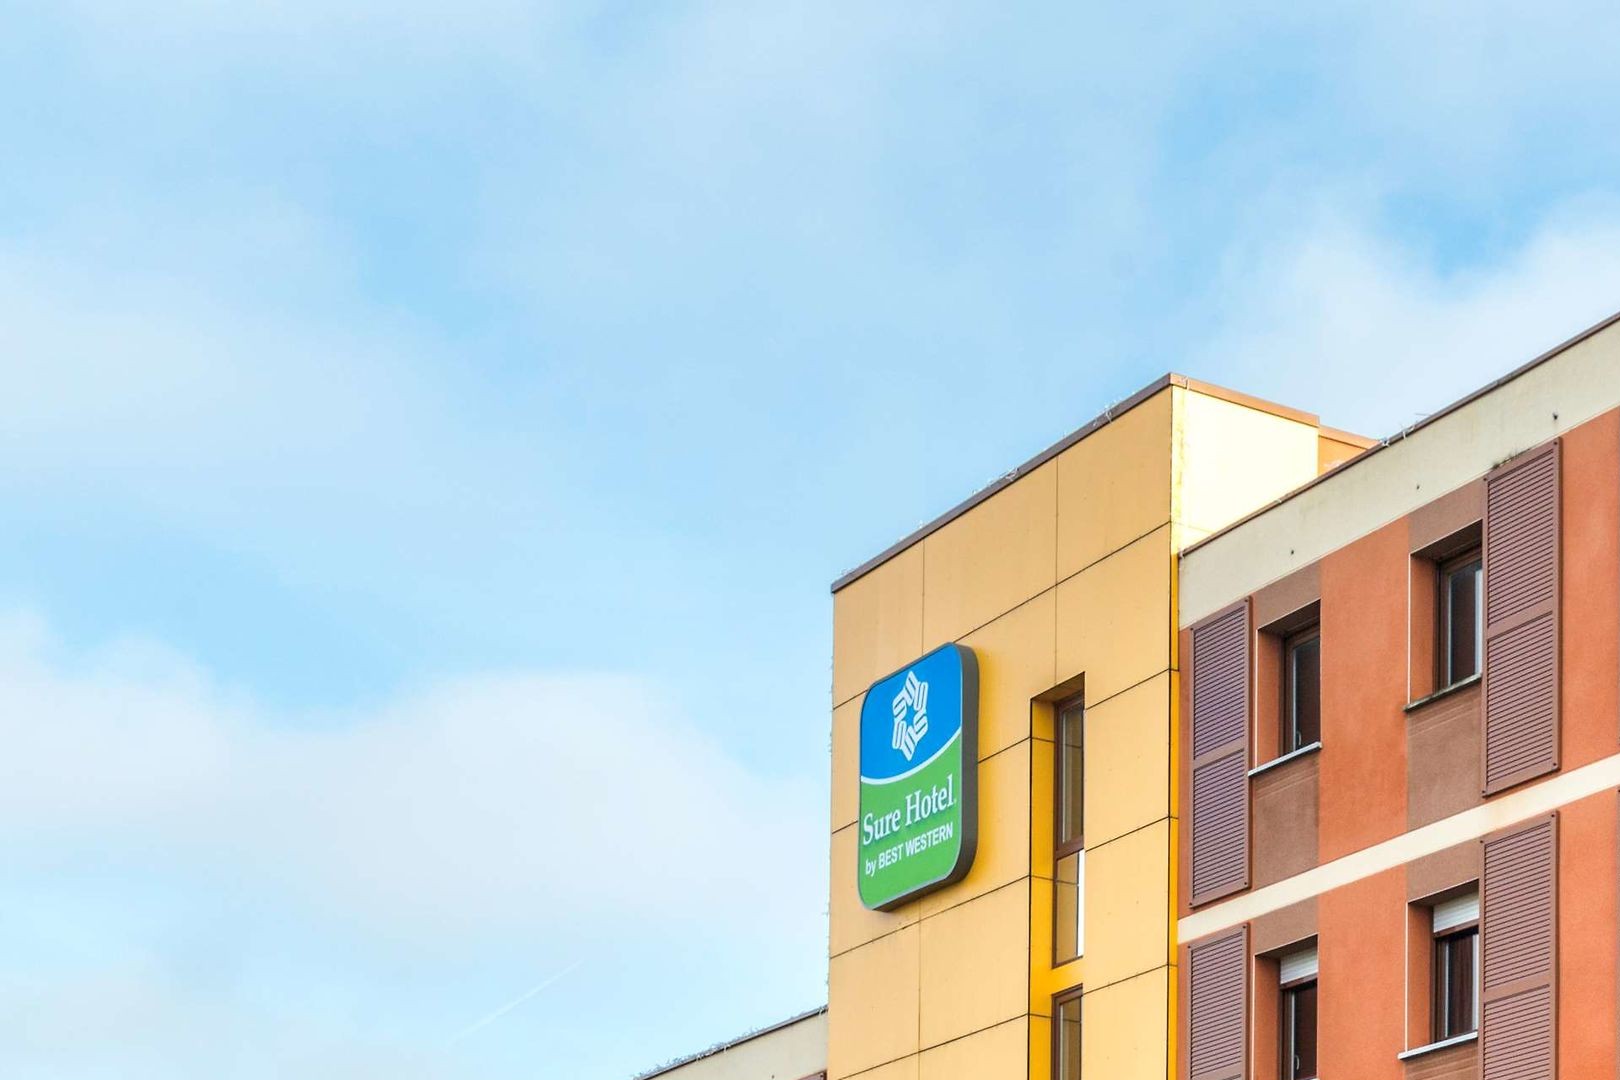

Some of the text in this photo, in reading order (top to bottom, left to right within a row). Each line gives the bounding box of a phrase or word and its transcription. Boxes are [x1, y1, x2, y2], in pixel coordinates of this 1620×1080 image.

[863, 773, 954, 845] Sure Hotel
[865, 822, 953, 877] by BEST WESTERN
